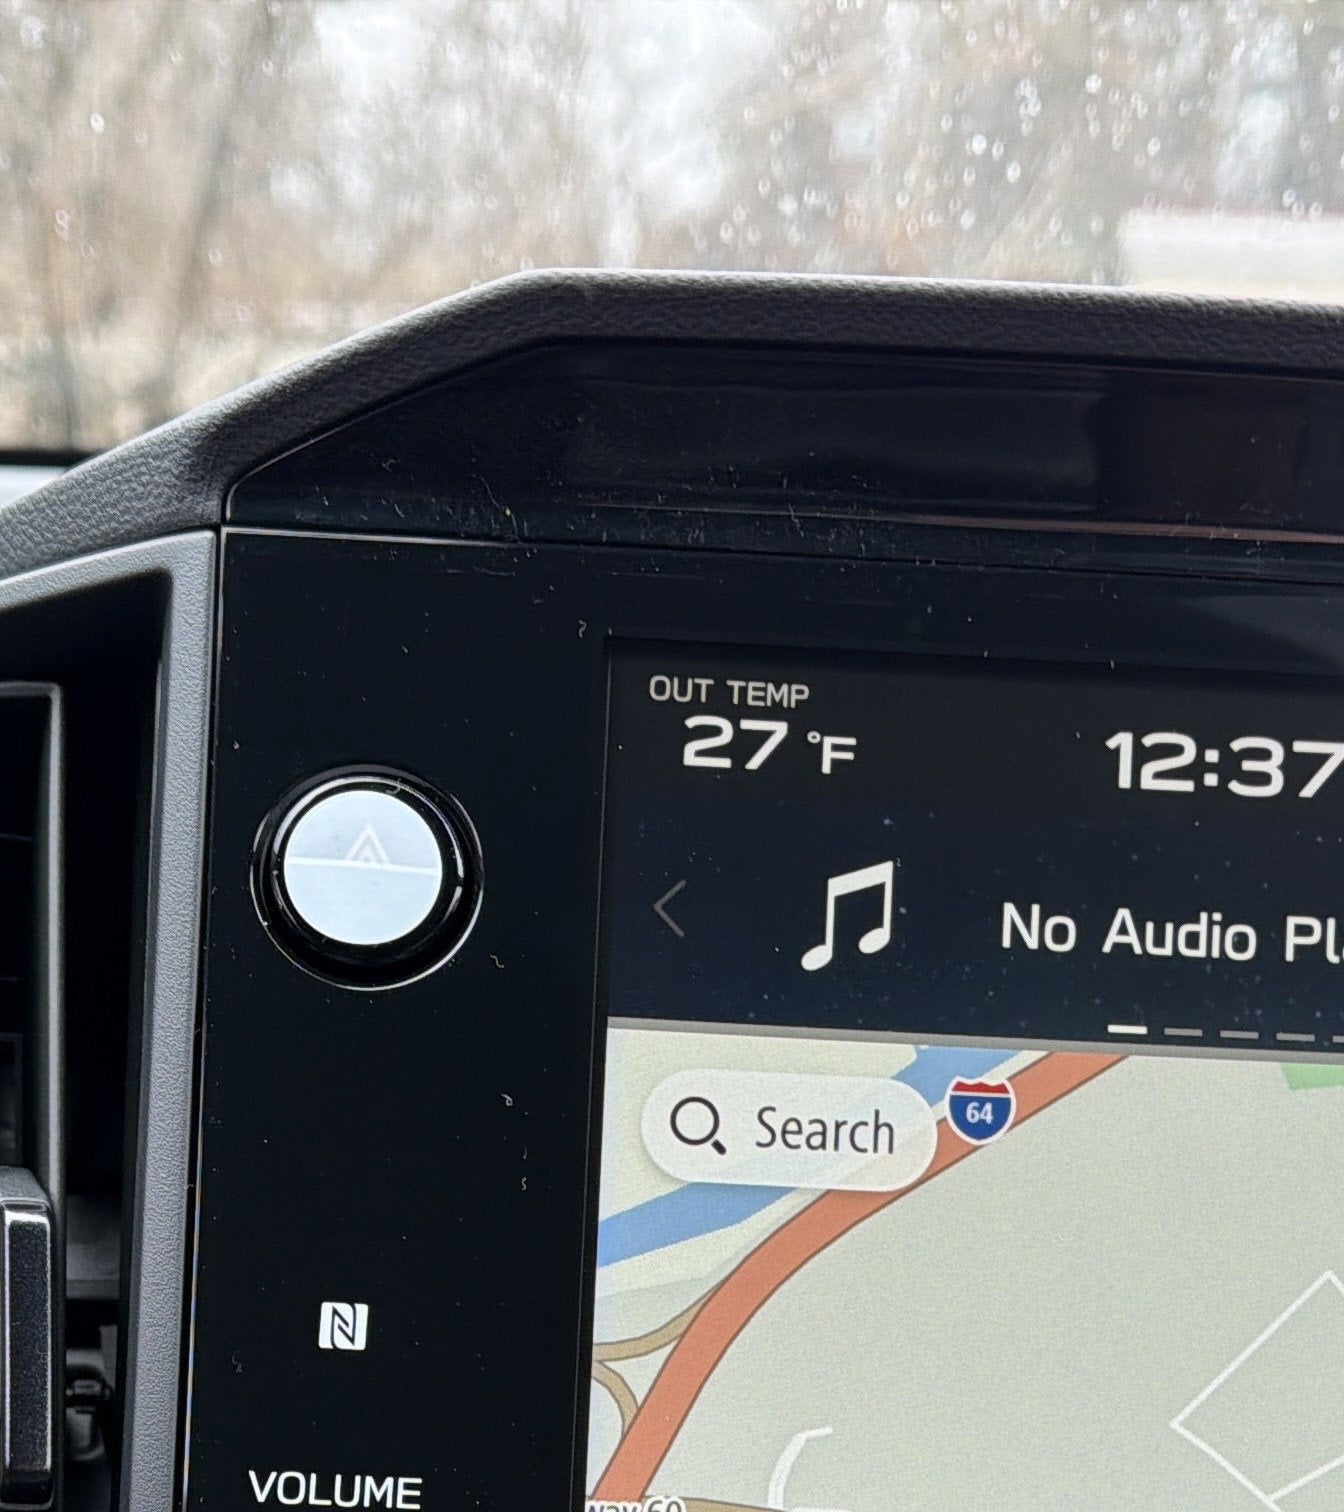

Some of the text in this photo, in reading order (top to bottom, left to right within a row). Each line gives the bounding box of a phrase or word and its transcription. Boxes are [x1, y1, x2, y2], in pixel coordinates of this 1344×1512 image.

[649, 674, 810, 709] OUT TEMP
[682, 715, 790, 771] 27
[1001, 903, 1076, 954] No
[1103, 909, 1256, 961] Audio
[755, 1107, 895, 1155] Search
[966, 1102, 993, 1125] 64
[248, 1469, 423, 1510] VOLUME
